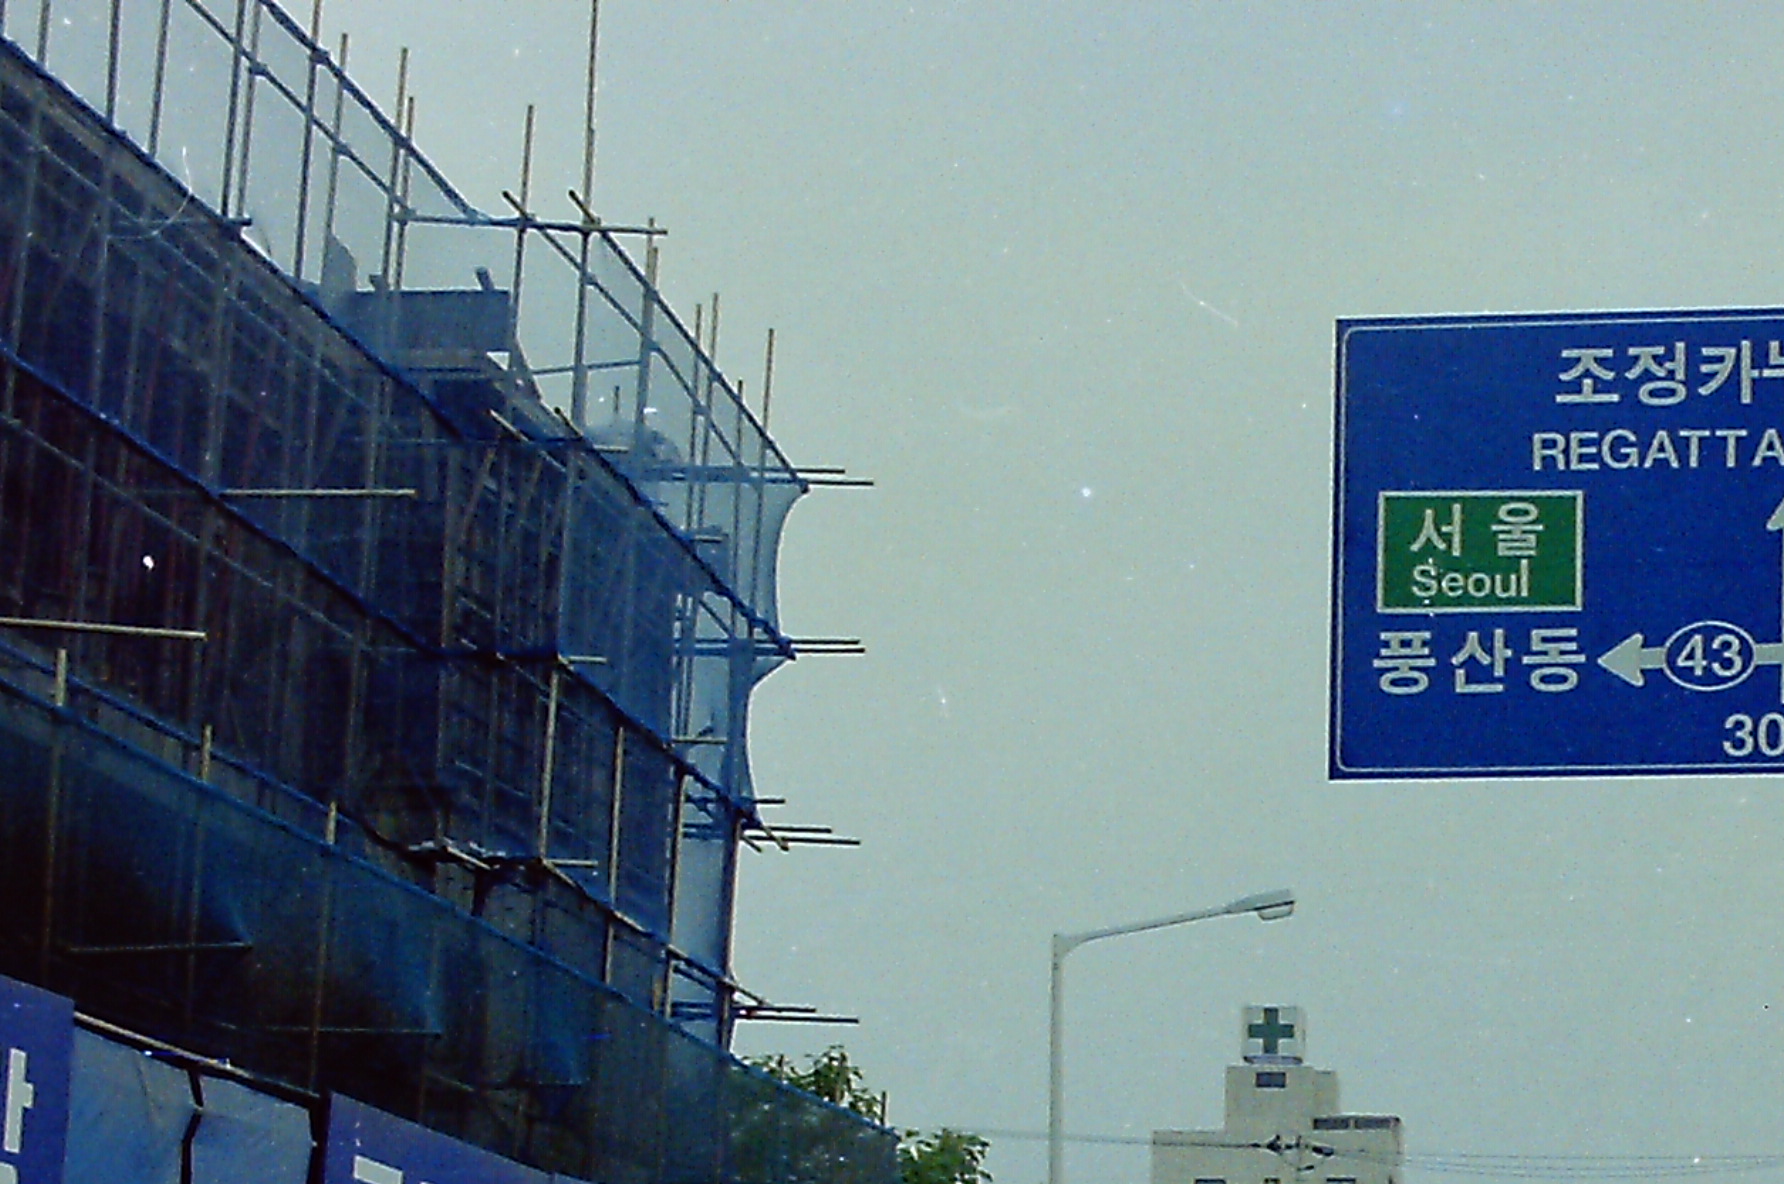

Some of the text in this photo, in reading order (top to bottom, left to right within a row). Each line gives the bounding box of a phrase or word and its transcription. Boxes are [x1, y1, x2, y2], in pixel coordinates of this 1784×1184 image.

[1411, 558, 1530, 599] Seoul
[1372, 627, 1587, 695] 풍산동
[1675, 634, 1743, 678] 43
